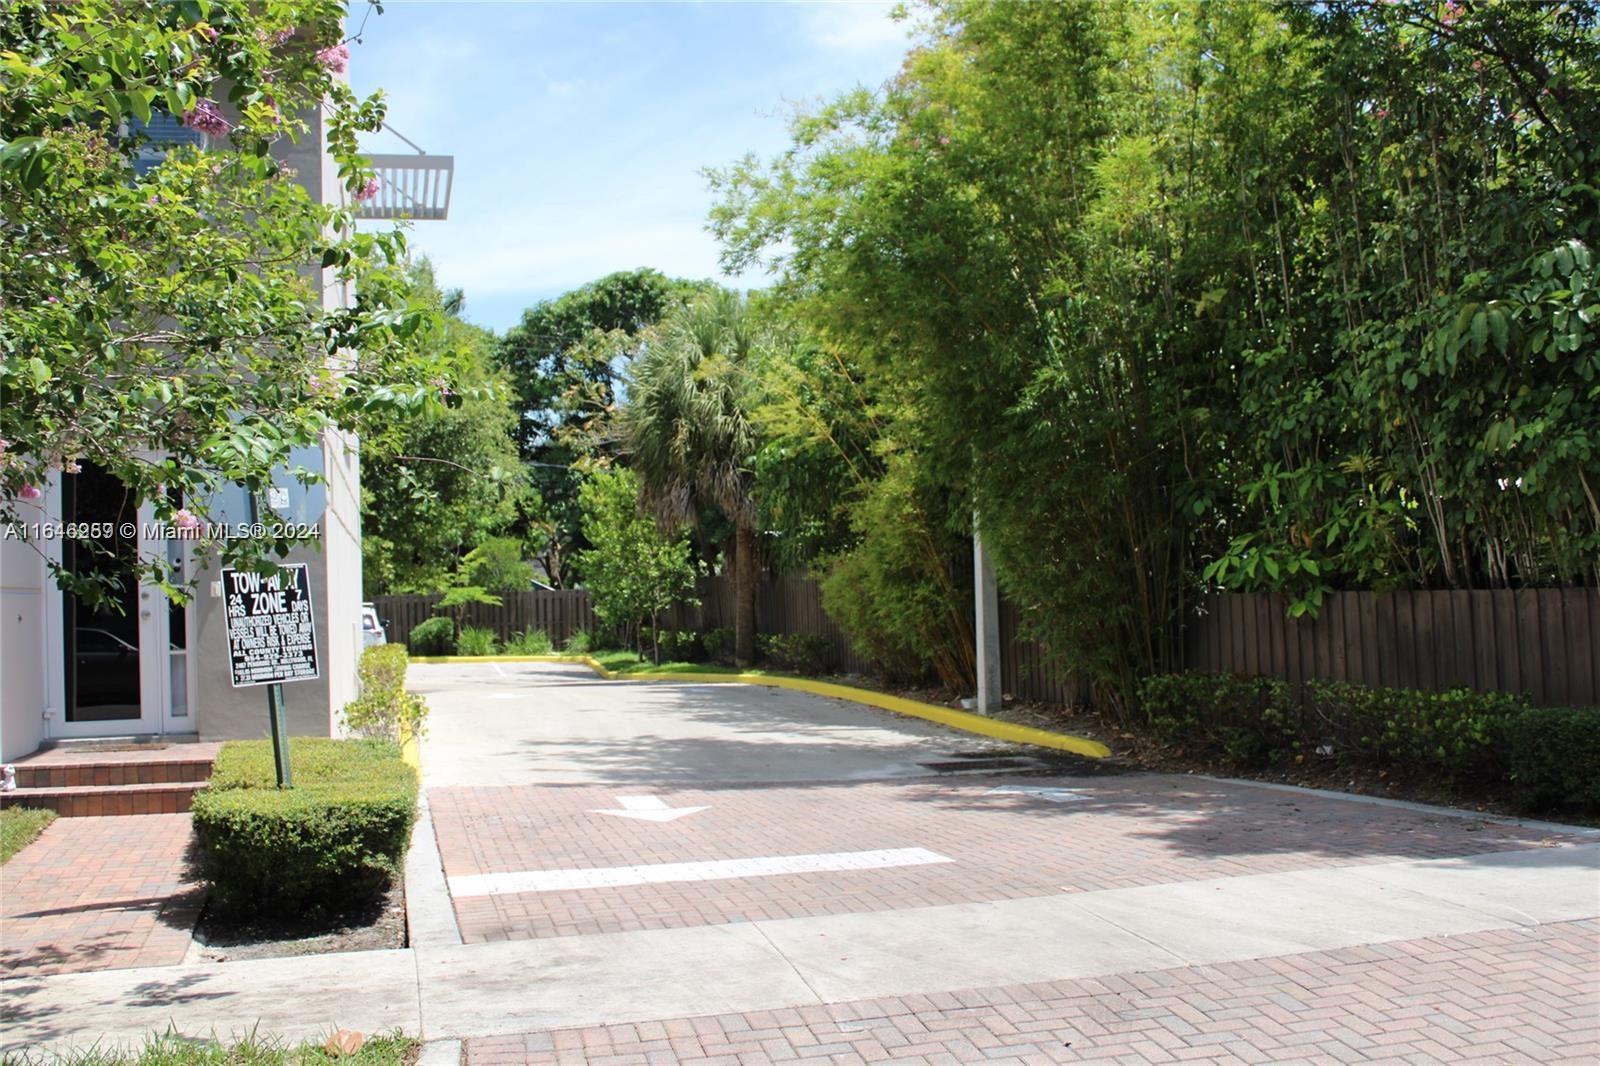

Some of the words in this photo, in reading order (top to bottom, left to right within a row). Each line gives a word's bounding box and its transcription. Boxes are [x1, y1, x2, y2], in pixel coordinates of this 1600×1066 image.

[230, 594, 242, 605] 24
[295, 590, 302, 600] 7
[251, 592, 287, 615] ZONE
[291, 600, 308, 612] DAYS
[228, 605, 246, 617] HRS
[273, 613, 299, 624] VEHICLES
[300, 612, 309, 622] OR
[230, 627, 254, 640] VESSELS
[255, 626, 268, 637] WILL
[269, 625, 277, 635] BE
[278, 624, 297, 635] TOWED
[241, 637, 265, 649] OWNERS
[266, 636, 280, 646] RISK
[287, 633, 312, 645] EXPENSE
[249, 647, 280, 655] COUNTY
